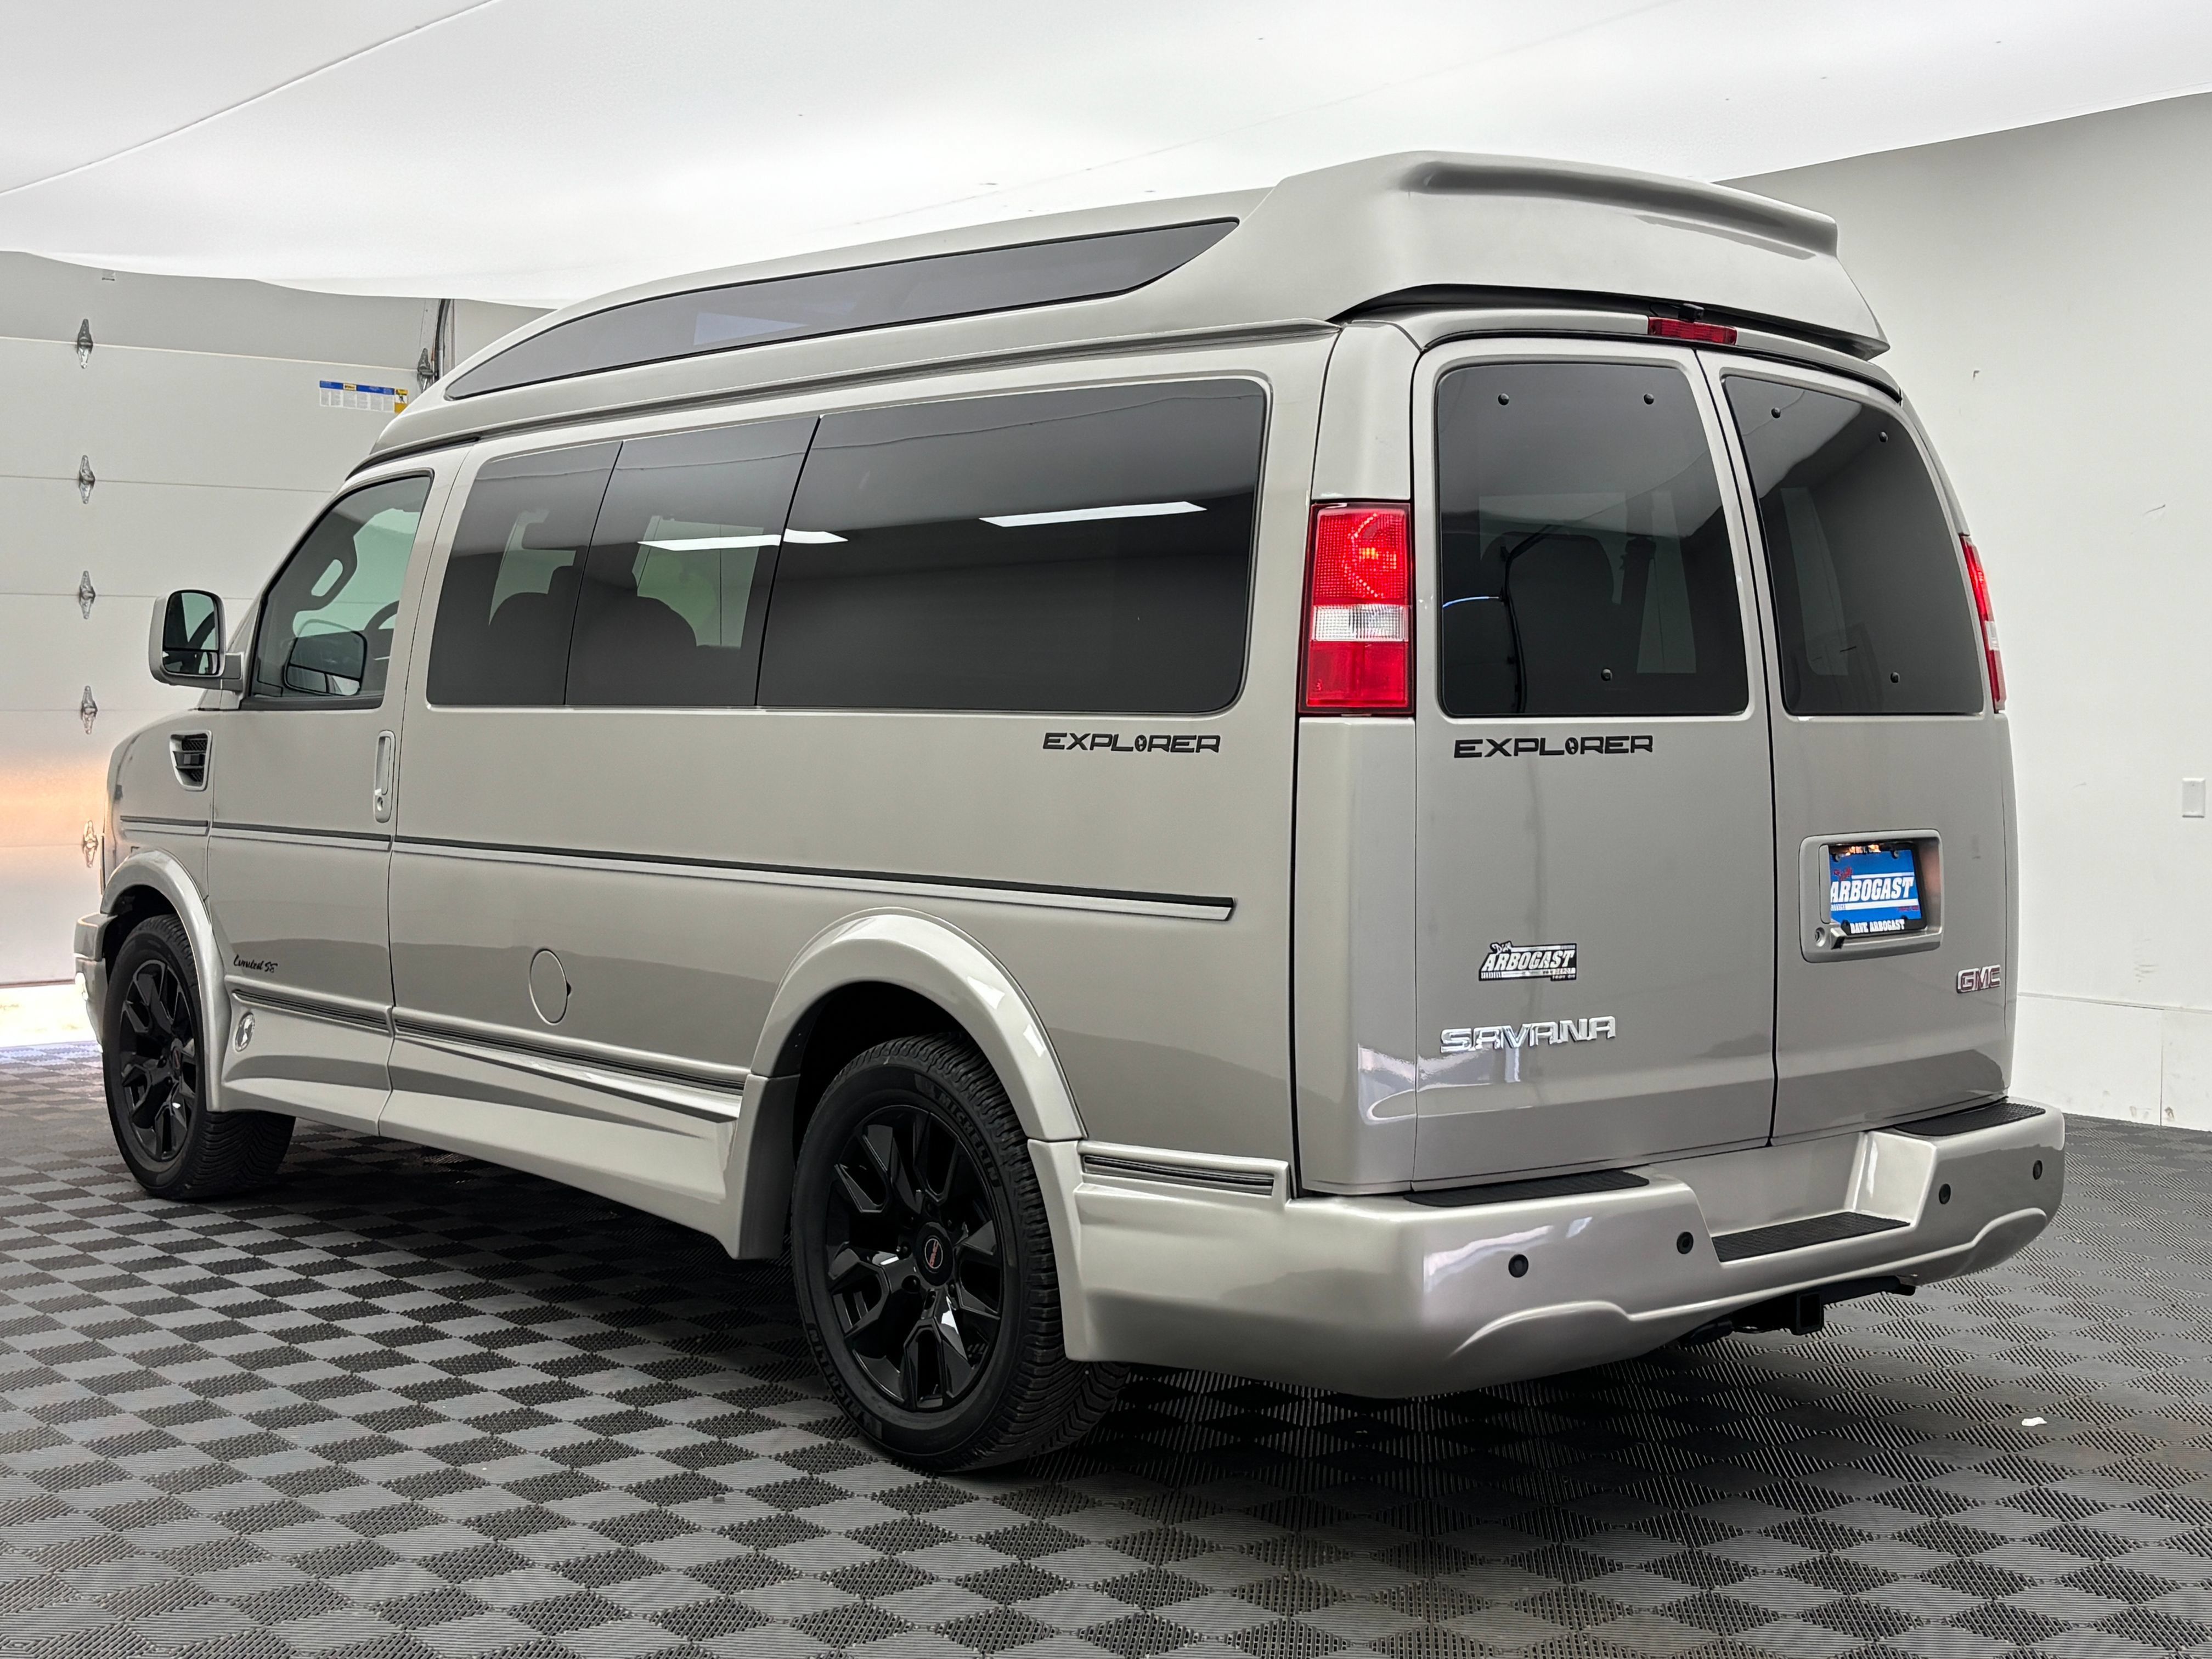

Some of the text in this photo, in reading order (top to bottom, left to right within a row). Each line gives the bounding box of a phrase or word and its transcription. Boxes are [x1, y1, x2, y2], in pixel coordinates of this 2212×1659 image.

[1042, 732, 1221, 753] EXPLORER
[1454, 735, 1653, 758] EXPLORER
[1830, 877, 1915, 903] ARBOGAST
[1850, 919, 1905, 934] DAVE ARBOGAST
[1481, 950, 1575, 972] ARBOGAST
[1957, 964, 2001, 993] GMC
[1440, 1015, 1616, 1053] SAVANA
[938, 1091, 997, 1180] MICHELIN
